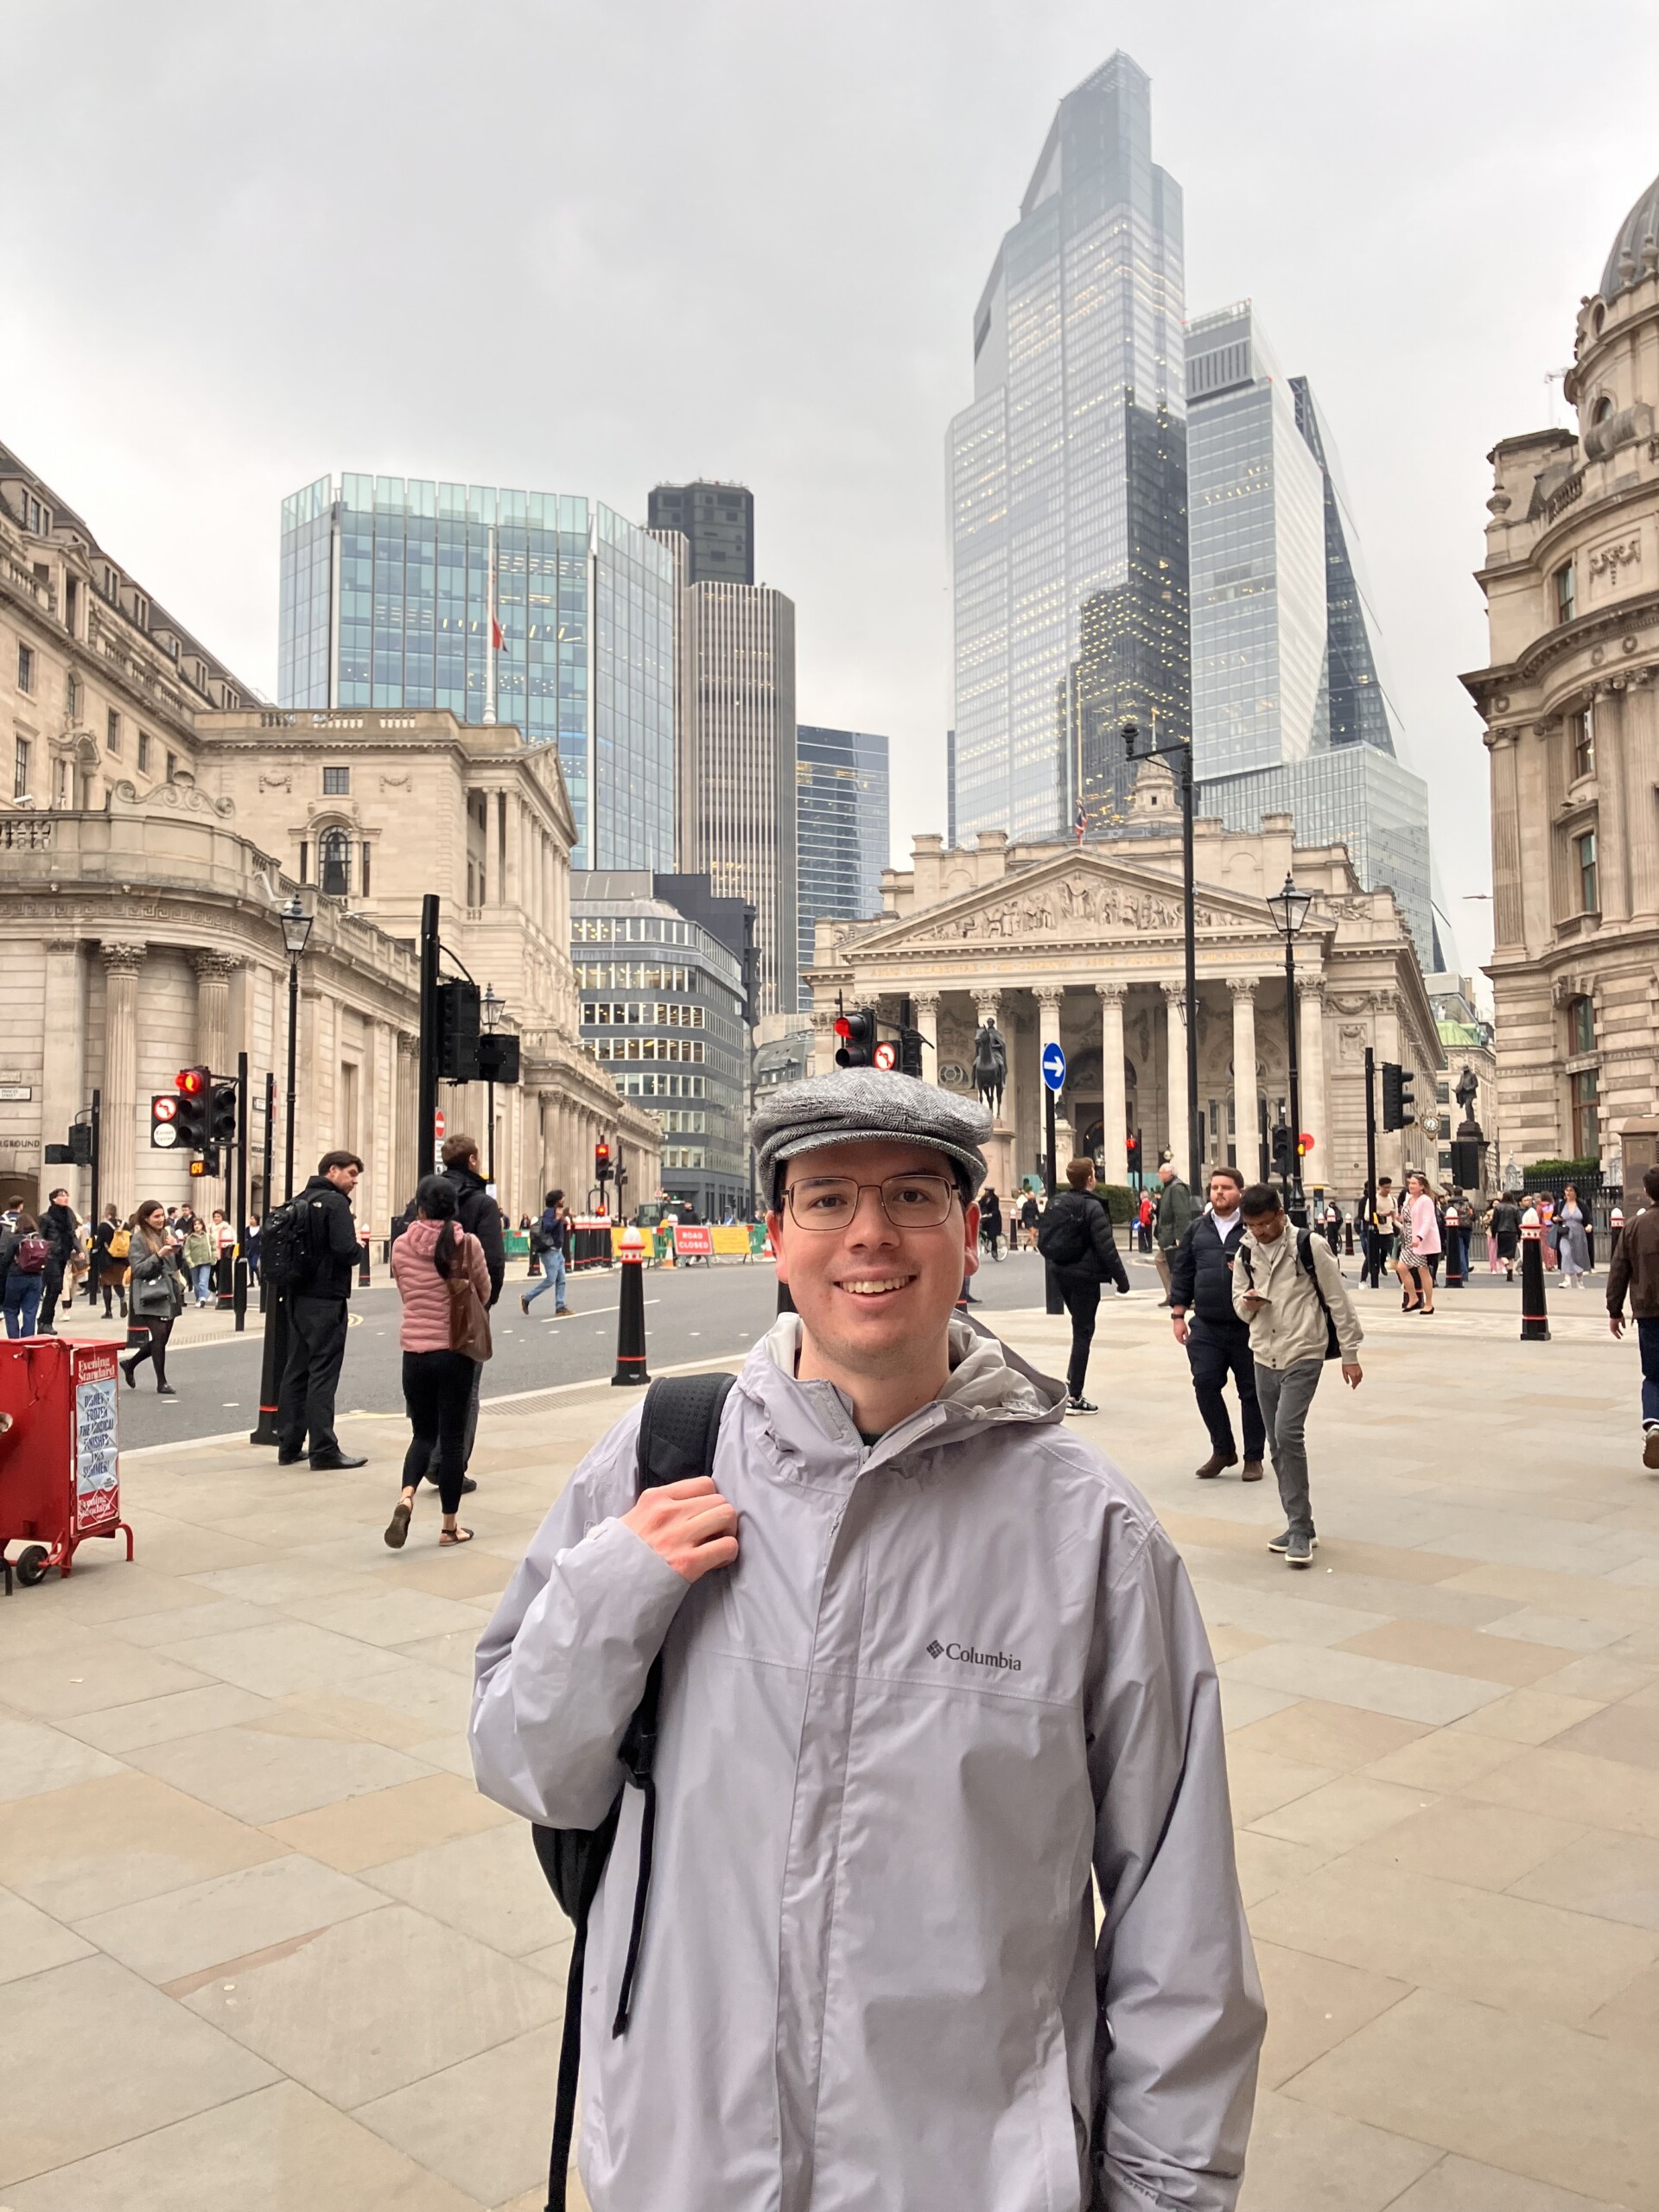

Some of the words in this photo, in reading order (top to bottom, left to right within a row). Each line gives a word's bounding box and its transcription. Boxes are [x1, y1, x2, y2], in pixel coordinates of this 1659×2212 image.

[79, 1357, 110, 1373] Evening
[79, 1365, 115, 1383] Standard
[79, 1424, 91, 1437] THE
[945, 1643, 1021, 1671] Columbia
